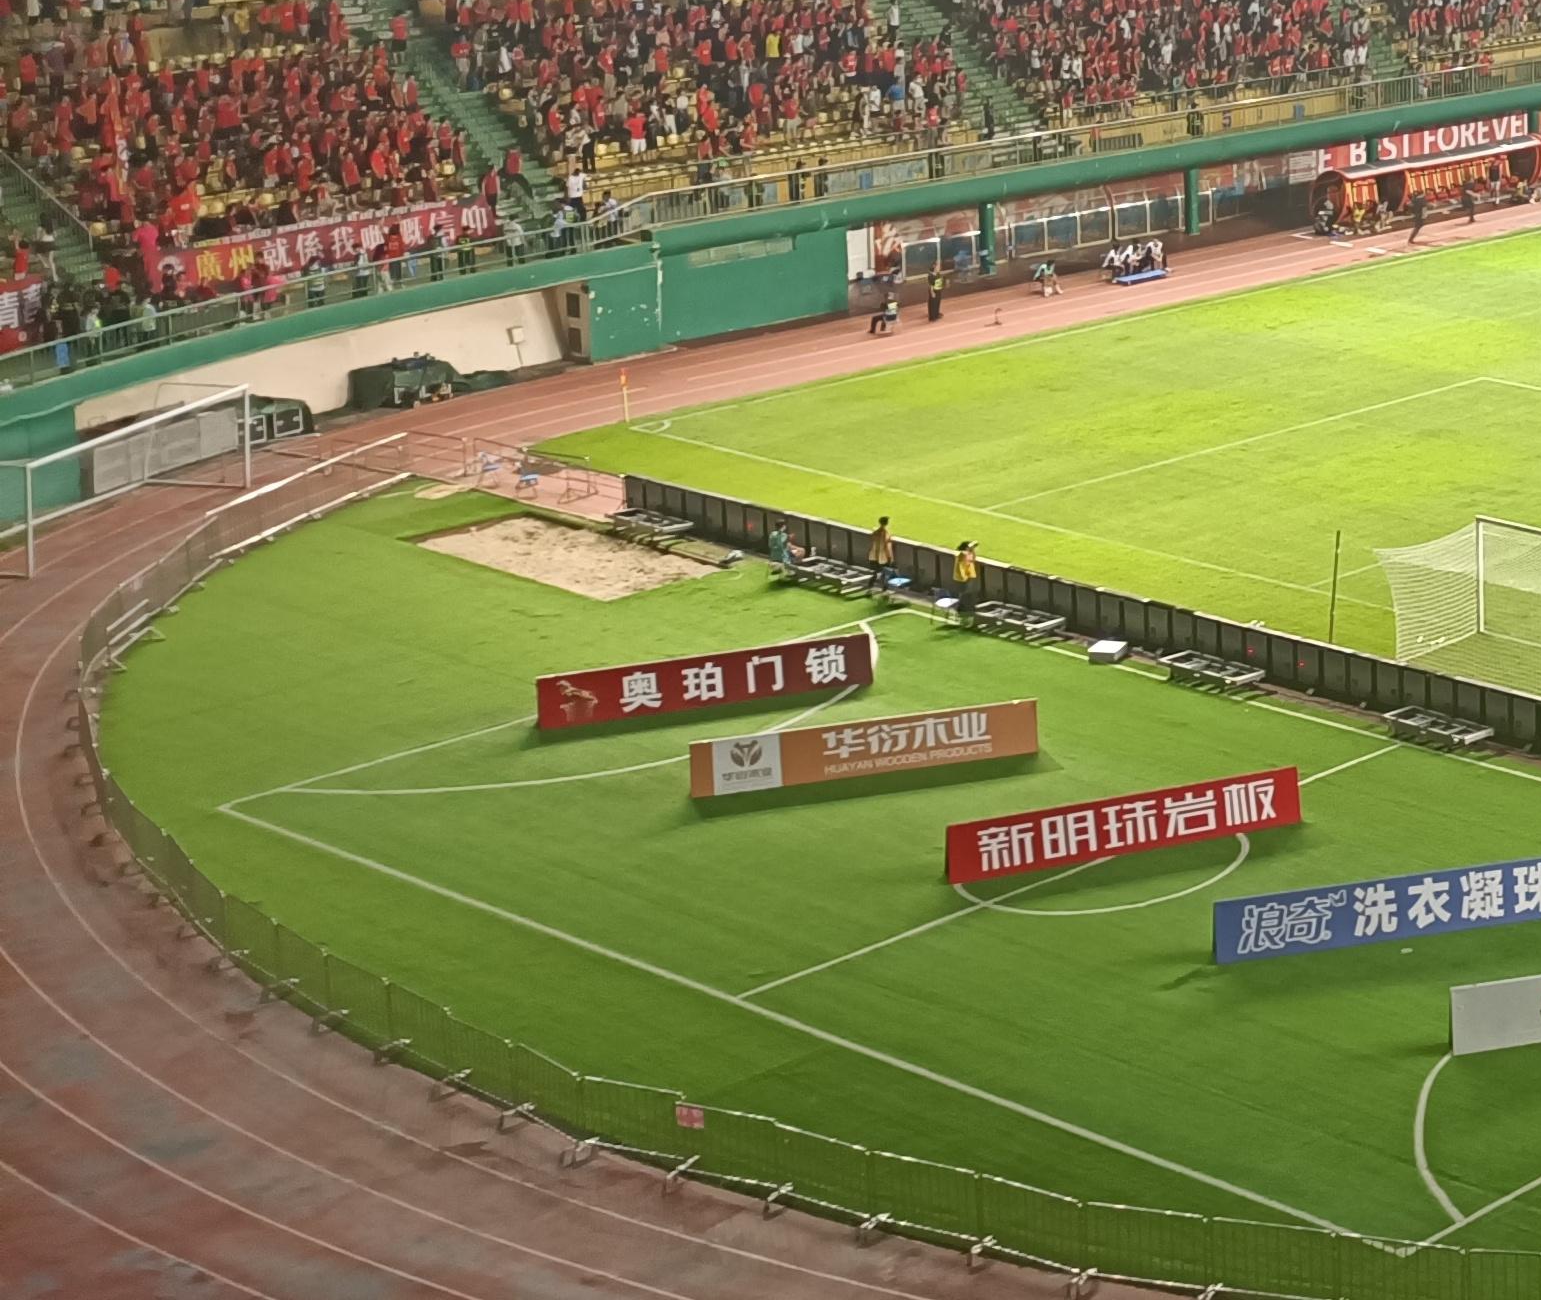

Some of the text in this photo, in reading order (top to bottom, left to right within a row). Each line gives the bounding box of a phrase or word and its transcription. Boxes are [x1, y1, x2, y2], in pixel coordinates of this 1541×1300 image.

[1349, 133, 1409, 166] BST
[619, 644, 848, 713] 奥珀门锁
[821, 711, 992, 758] 华衍木业
[824, 743, 993, 775] HUAYAN WOODEN PRODUCTS
[977, 778, 1277, 872] 新明珠岩板
[1237, 896, 1333, 954] 浪奇
